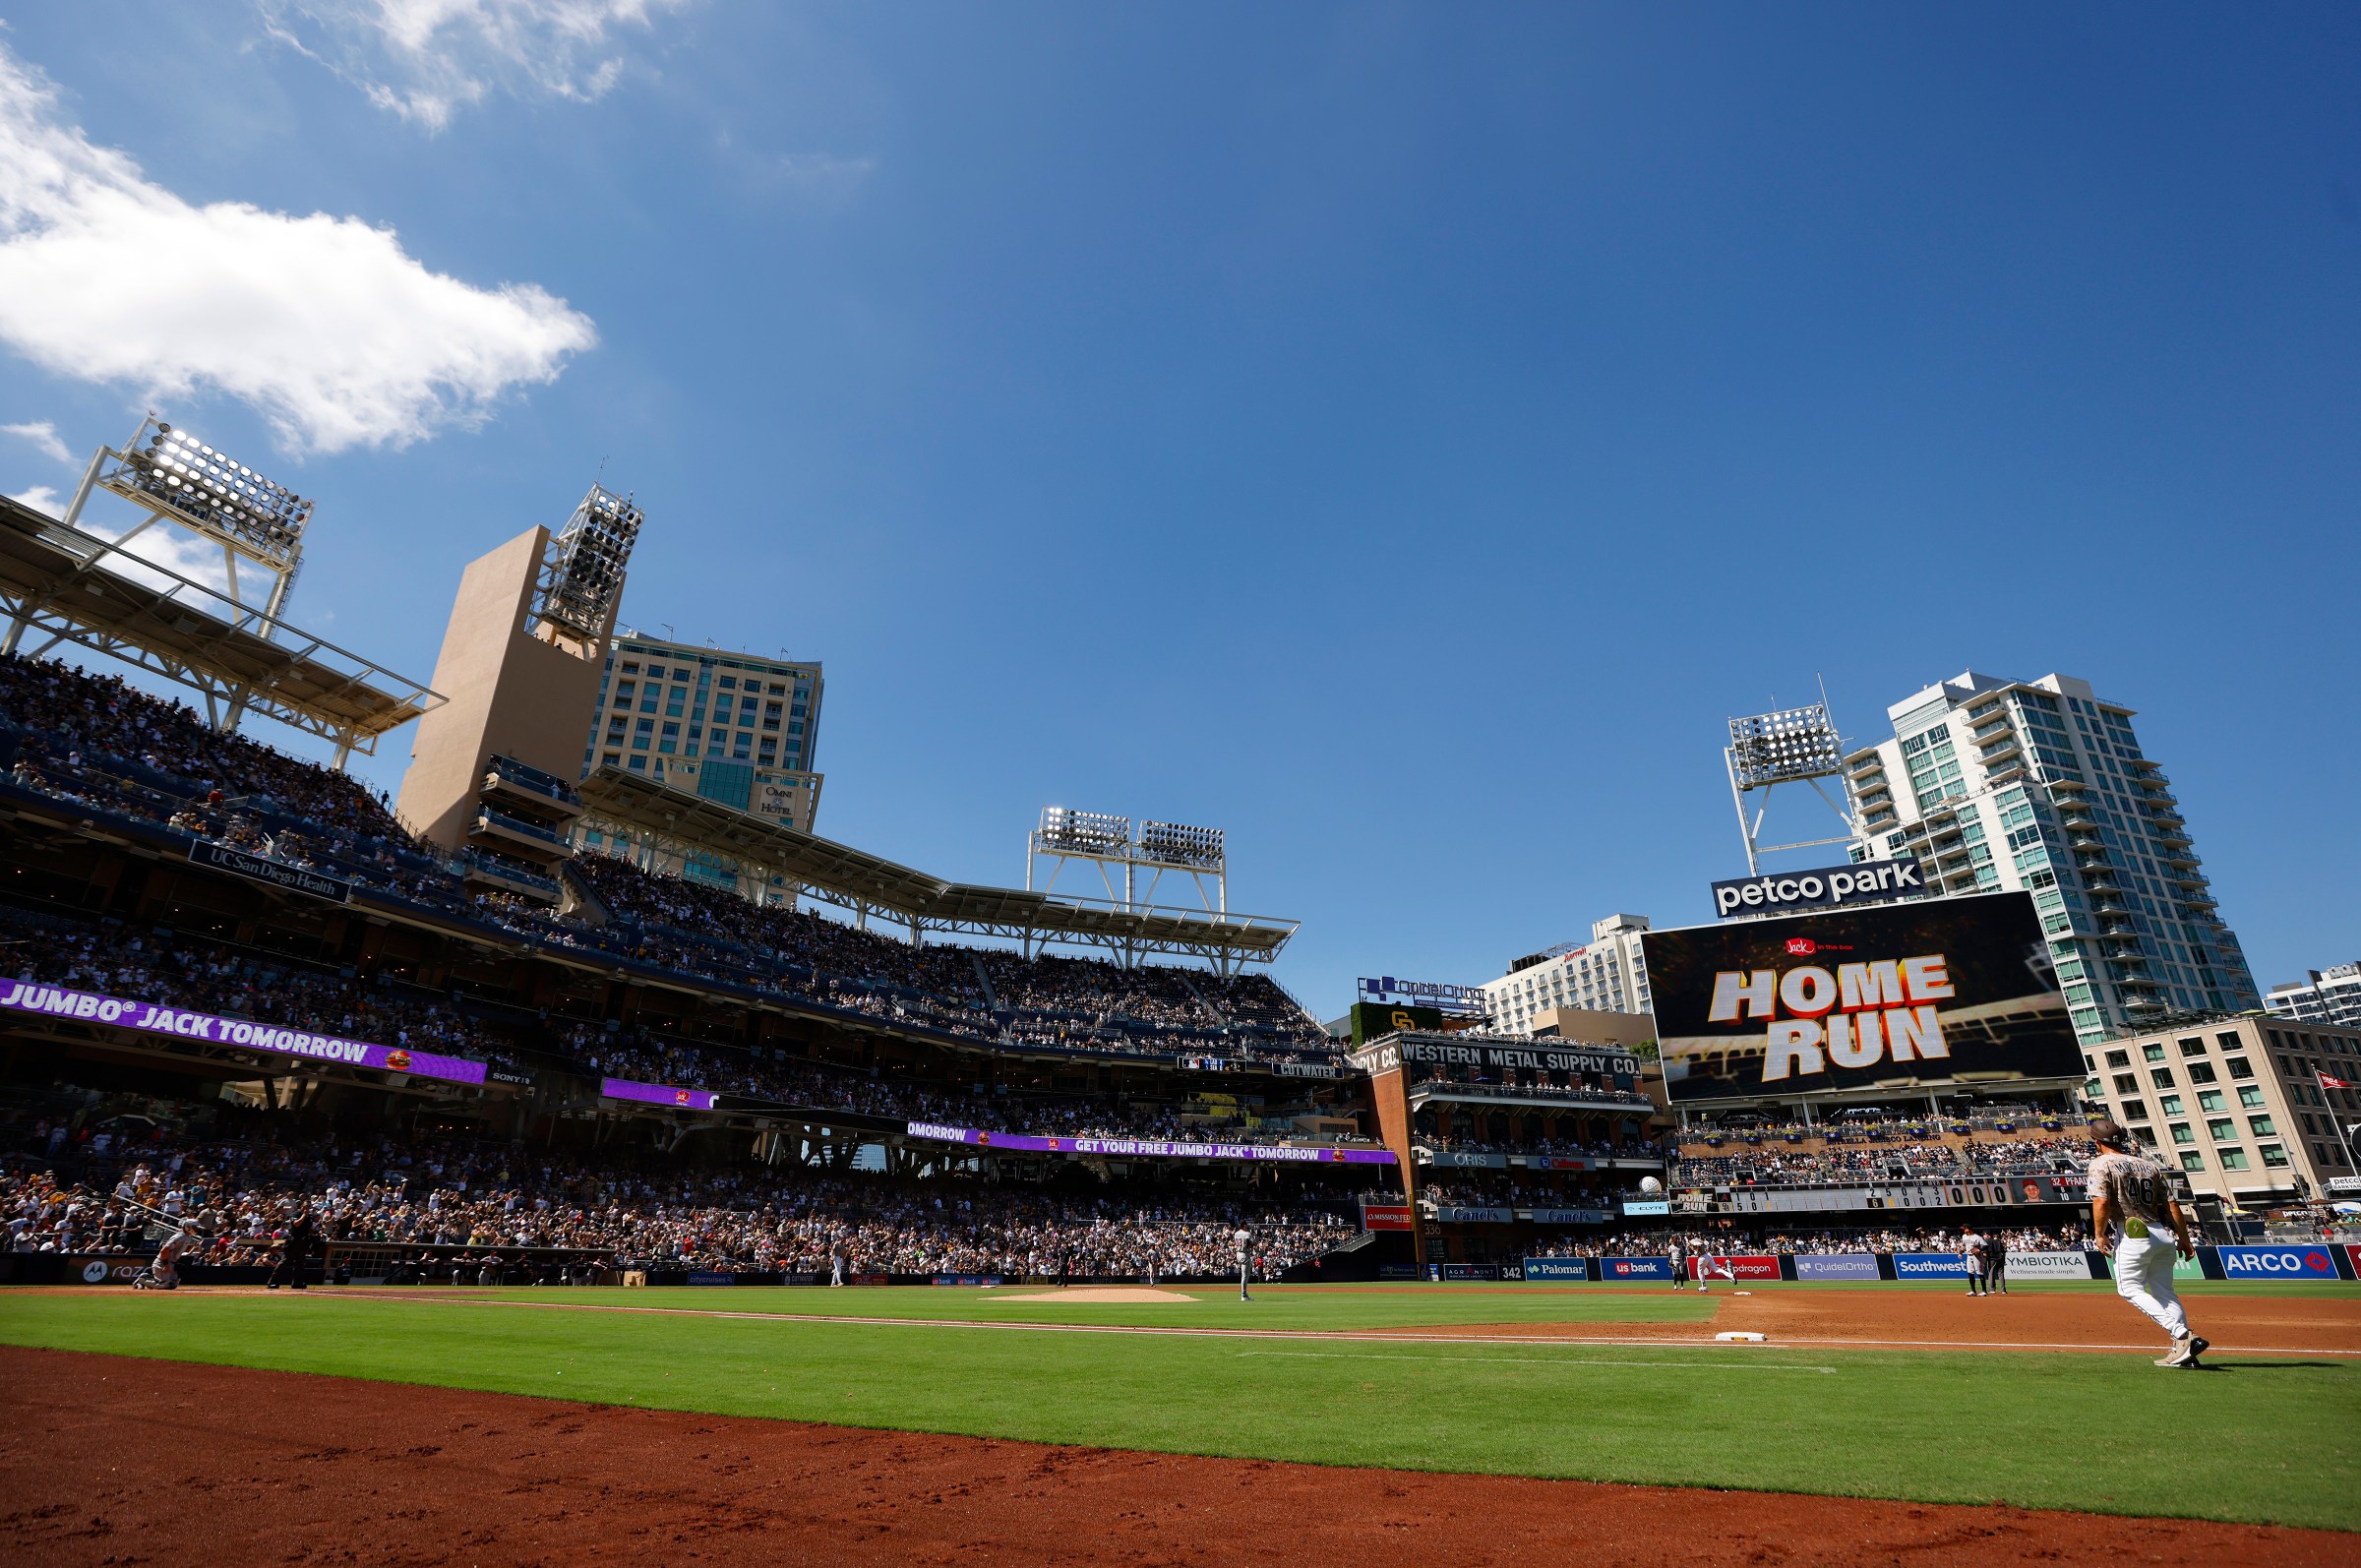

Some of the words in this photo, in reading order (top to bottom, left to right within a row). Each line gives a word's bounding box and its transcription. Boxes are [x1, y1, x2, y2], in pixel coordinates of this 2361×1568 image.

[765, 787, 792, 798] OMNI
[761, 803, 792, 814] HOTEL
[210, 848, 233, 867] UC
[232, 856, 259, 874] San
[261, 864, 295, 884] Diego
[296, 874, 335, 895] Health
[1717, 876, 1824, 916] petco
[1828, 863, 1921, 903] park
[1787, 938, 1814, 953] Jack
[1708, 954, 1955, 1024] HOME
[137, 1007, 213, 1037] JACK
[218, 1019, 369, 1062] TOMORROW
[1762, 1004, 1951, 1082] RUN
[1400, 1043, 1482, 1064] WESTERN
[1488, 1049, 1544, 1068] METAL
[1546, 1053, 1606, 1073] SUPPLY
[1612, 1057, 1640, 1075] CO.
[1280, 1063, 1337, 1078] CUTWATER
[493, 1072, 520, 1083] SONY
[1075, 1139, 1100, 1152] GET
[1102, 1141, 1136, 1154] YOUR
[1138, 1143, 1169, 1155] FREE
[1170, 1144, 1213, 1156] JUMBO
[1251, 1147, 1319, 1160] TOMORROW
[1454, 1154, 1487, 1167] ORIS
[2051, 1176, 2062, 1186] 32
[1750, 1191, 1756, 1201] 0
[1869, 1188, 1877, 1197] 2
[1885, 1187, 1892, 1197] 5
[1901, 1186, 1907, 1197] 0
[1917, 1186, 1924, 1196] 4
[1933, 1185, 1940, 1195] 3
[1952, 1187, 1964, 1204] 0
[1972, 1186, 1985, 1204] 0
[1994, 1185, 2007, 1203] 0
[2060, 1192, 2069, 1201] 10
[2128, 1176, 2154, 1206] 46
[1677, 1193, 1714, 1203] HOME
[1737, 1202, 1743, 1211] 5
[1751, 1202, 1758, 1211] 0
[1872, 1198, 1879, 1208] 6
[1904, 1197, 1910, 1207] 0
[1919, 1197, 1926, 1207] 0
[1936, 1196, 1943, 1206] 2
[1683, 1202, 1708, 1211] RUN
[1424, 1223, 1441, 1236] 336
[1616, 1263, 1629, 1273] us
[1631, 1262, 1657, 1273] bank
[2004, 1256, 2084, 1266] YMBIOTIKA
[2227, 1253, 2302, 1272] ARCO
[1502, 1266, 1522, 1279] 342
[1542, 1264, 1584, 1275] Palomar
[1815, 1263, 1874, 1273] QuidelOrtho
[690, 1275, 726, 1284] citycruises
